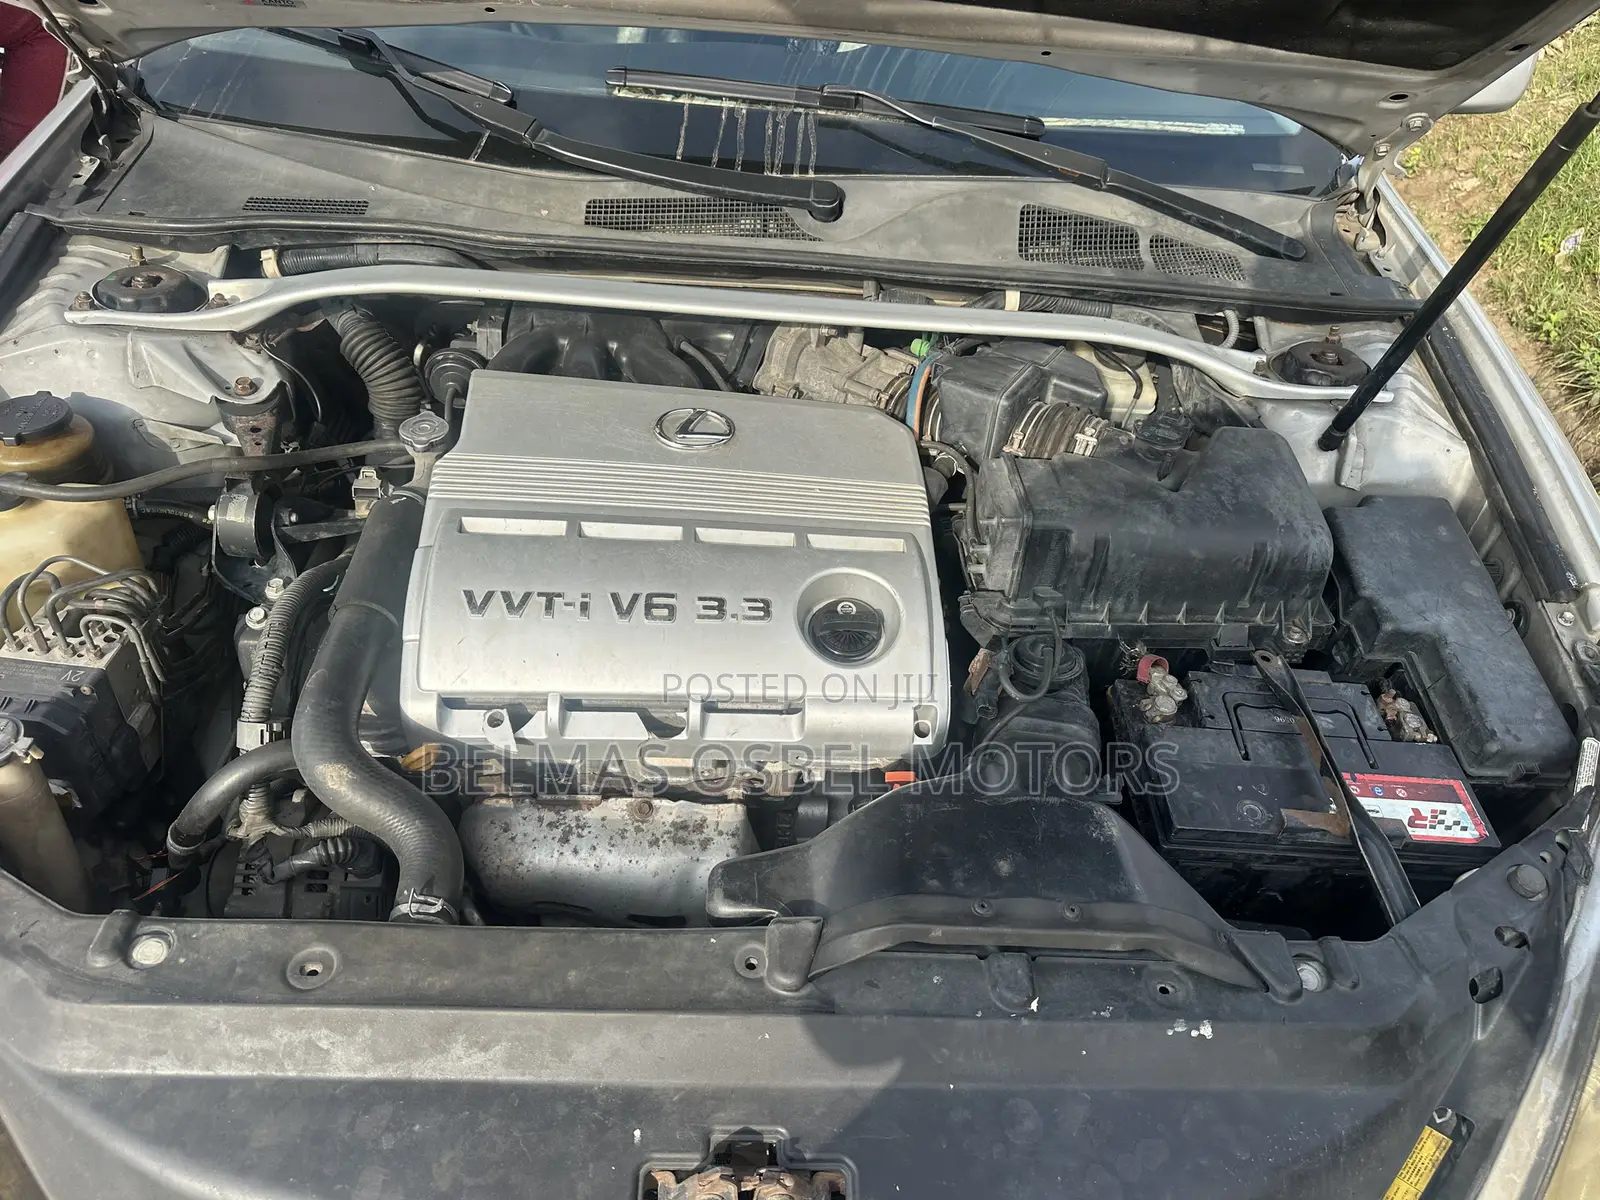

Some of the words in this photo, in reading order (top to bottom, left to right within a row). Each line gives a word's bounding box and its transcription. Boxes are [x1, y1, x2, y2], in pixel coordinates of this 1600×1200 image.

[461, 589, 592, 622] VVT-i
[608, 591, 678, 624] V6
[694, 596, 773, 624] 3.3
